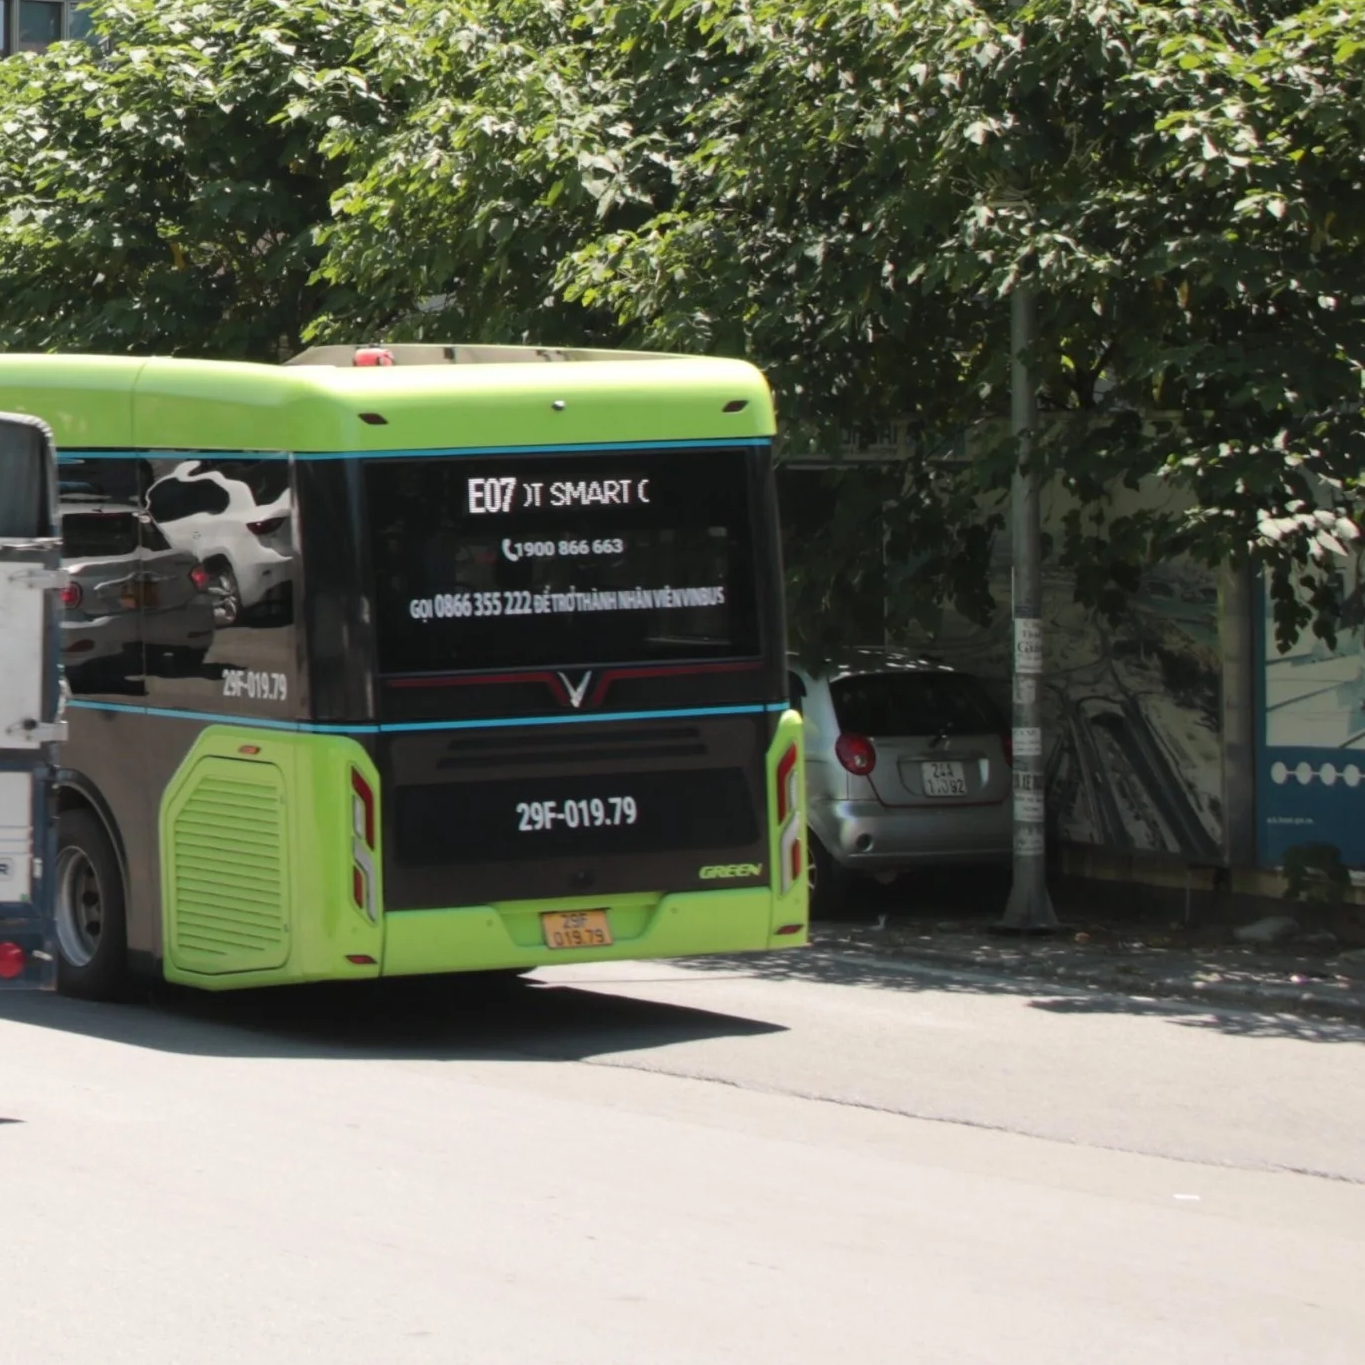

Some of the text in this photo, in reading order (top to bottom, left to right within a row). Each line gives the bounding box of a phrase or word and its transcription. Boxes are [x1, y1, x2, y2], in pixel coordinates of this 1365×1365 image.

[468, 477, 516, 513] E07
[550, 480, 632, 506] SMART
[516, 539, 624, 556] 1900 866 663
[410, 599, 433, 623] GỌI
[435, 594, 471, 618] 0866
[474, 592, 501, 616] 355
[504, 590, 532, 615] 222
[683, 586, 725, 608] VINBUS
[222, 668, 287, 700] 29F-019.79
[516, 796, 638, 831] 29F-019.79
[698, 862, 763, 880] GREEN
[561, 913, 588, 929] 29F
[553, 929, 606, 947] 019.79
